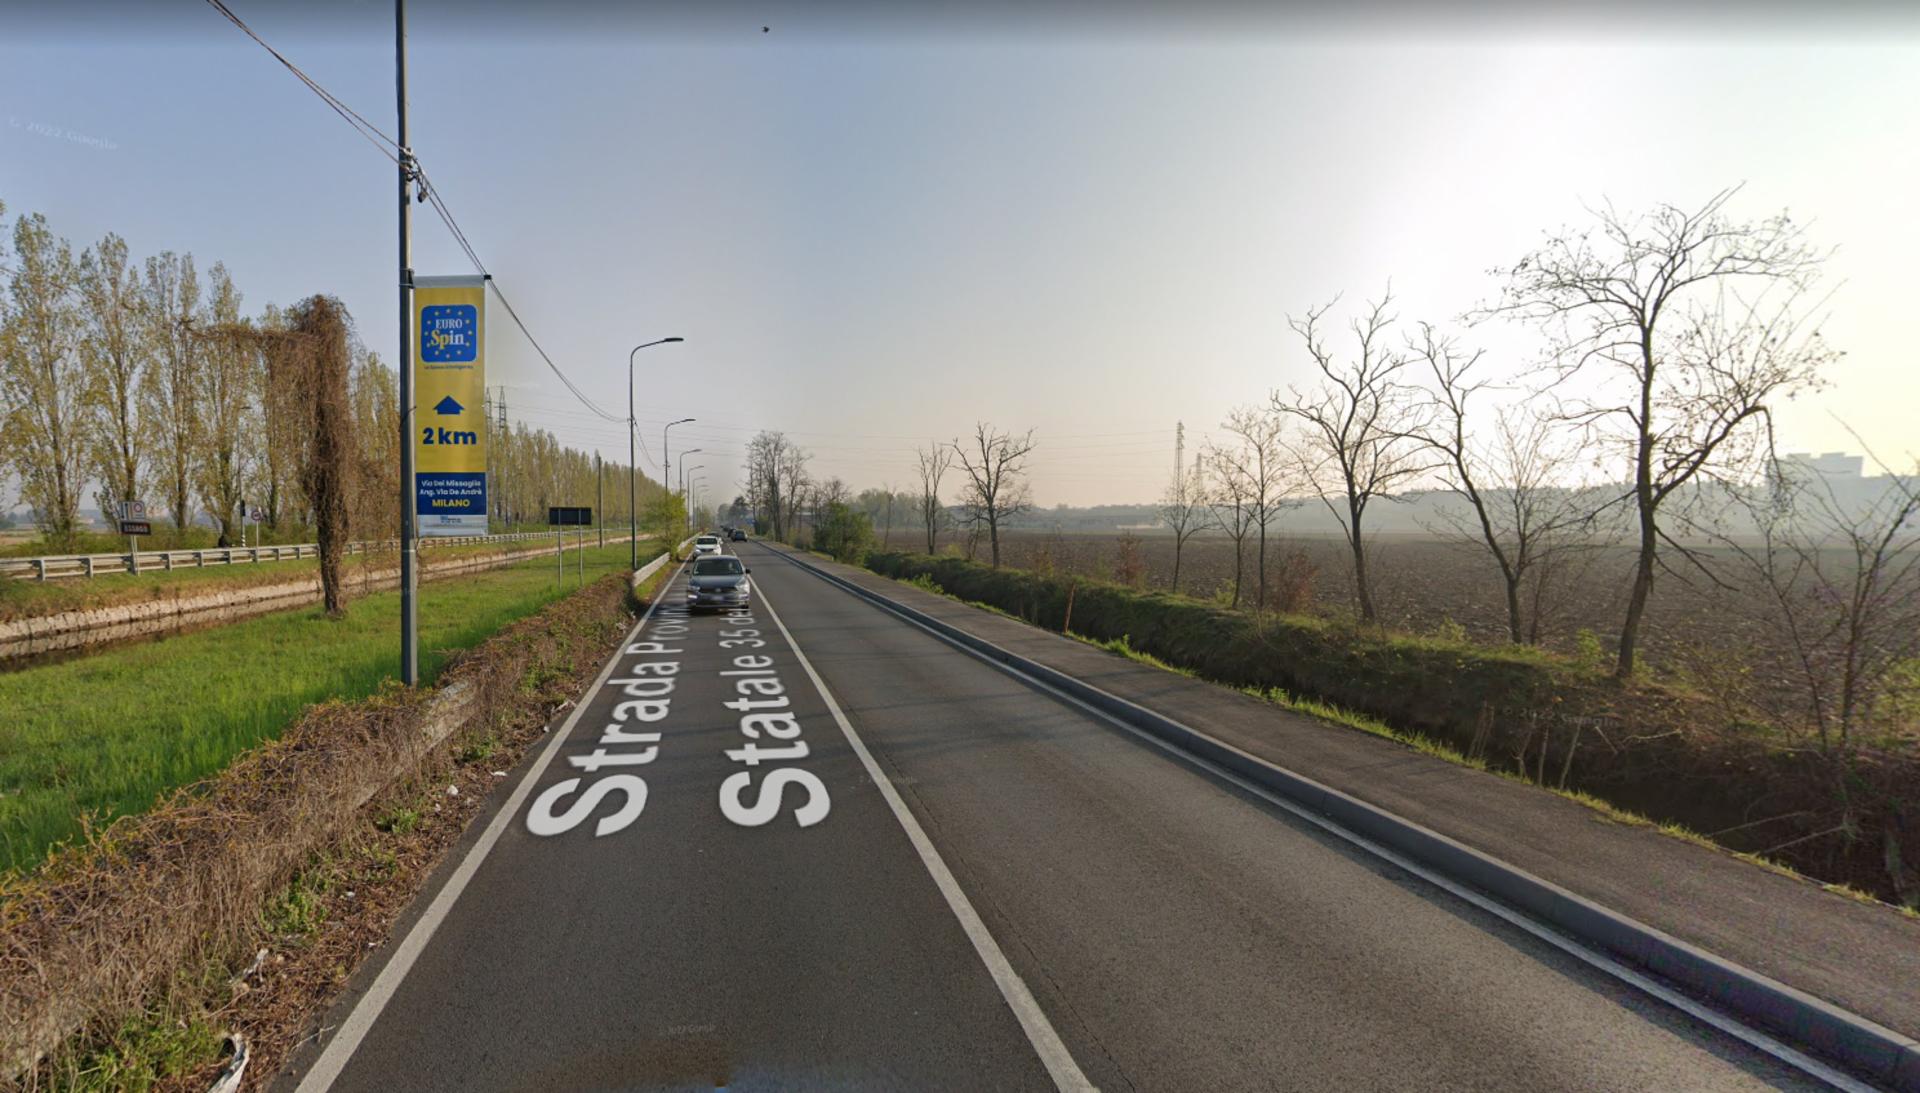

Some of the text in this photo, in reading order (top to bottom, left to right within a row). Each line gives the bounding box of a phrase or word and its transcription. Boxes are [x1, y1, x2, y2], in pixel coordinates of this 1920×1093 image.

[435, 318, 463, 329] EURO
[430, 329, 465, 350] Spin
[422, 427, 477, 445] 2 km
[431, 498, 471, 508] MILANO
